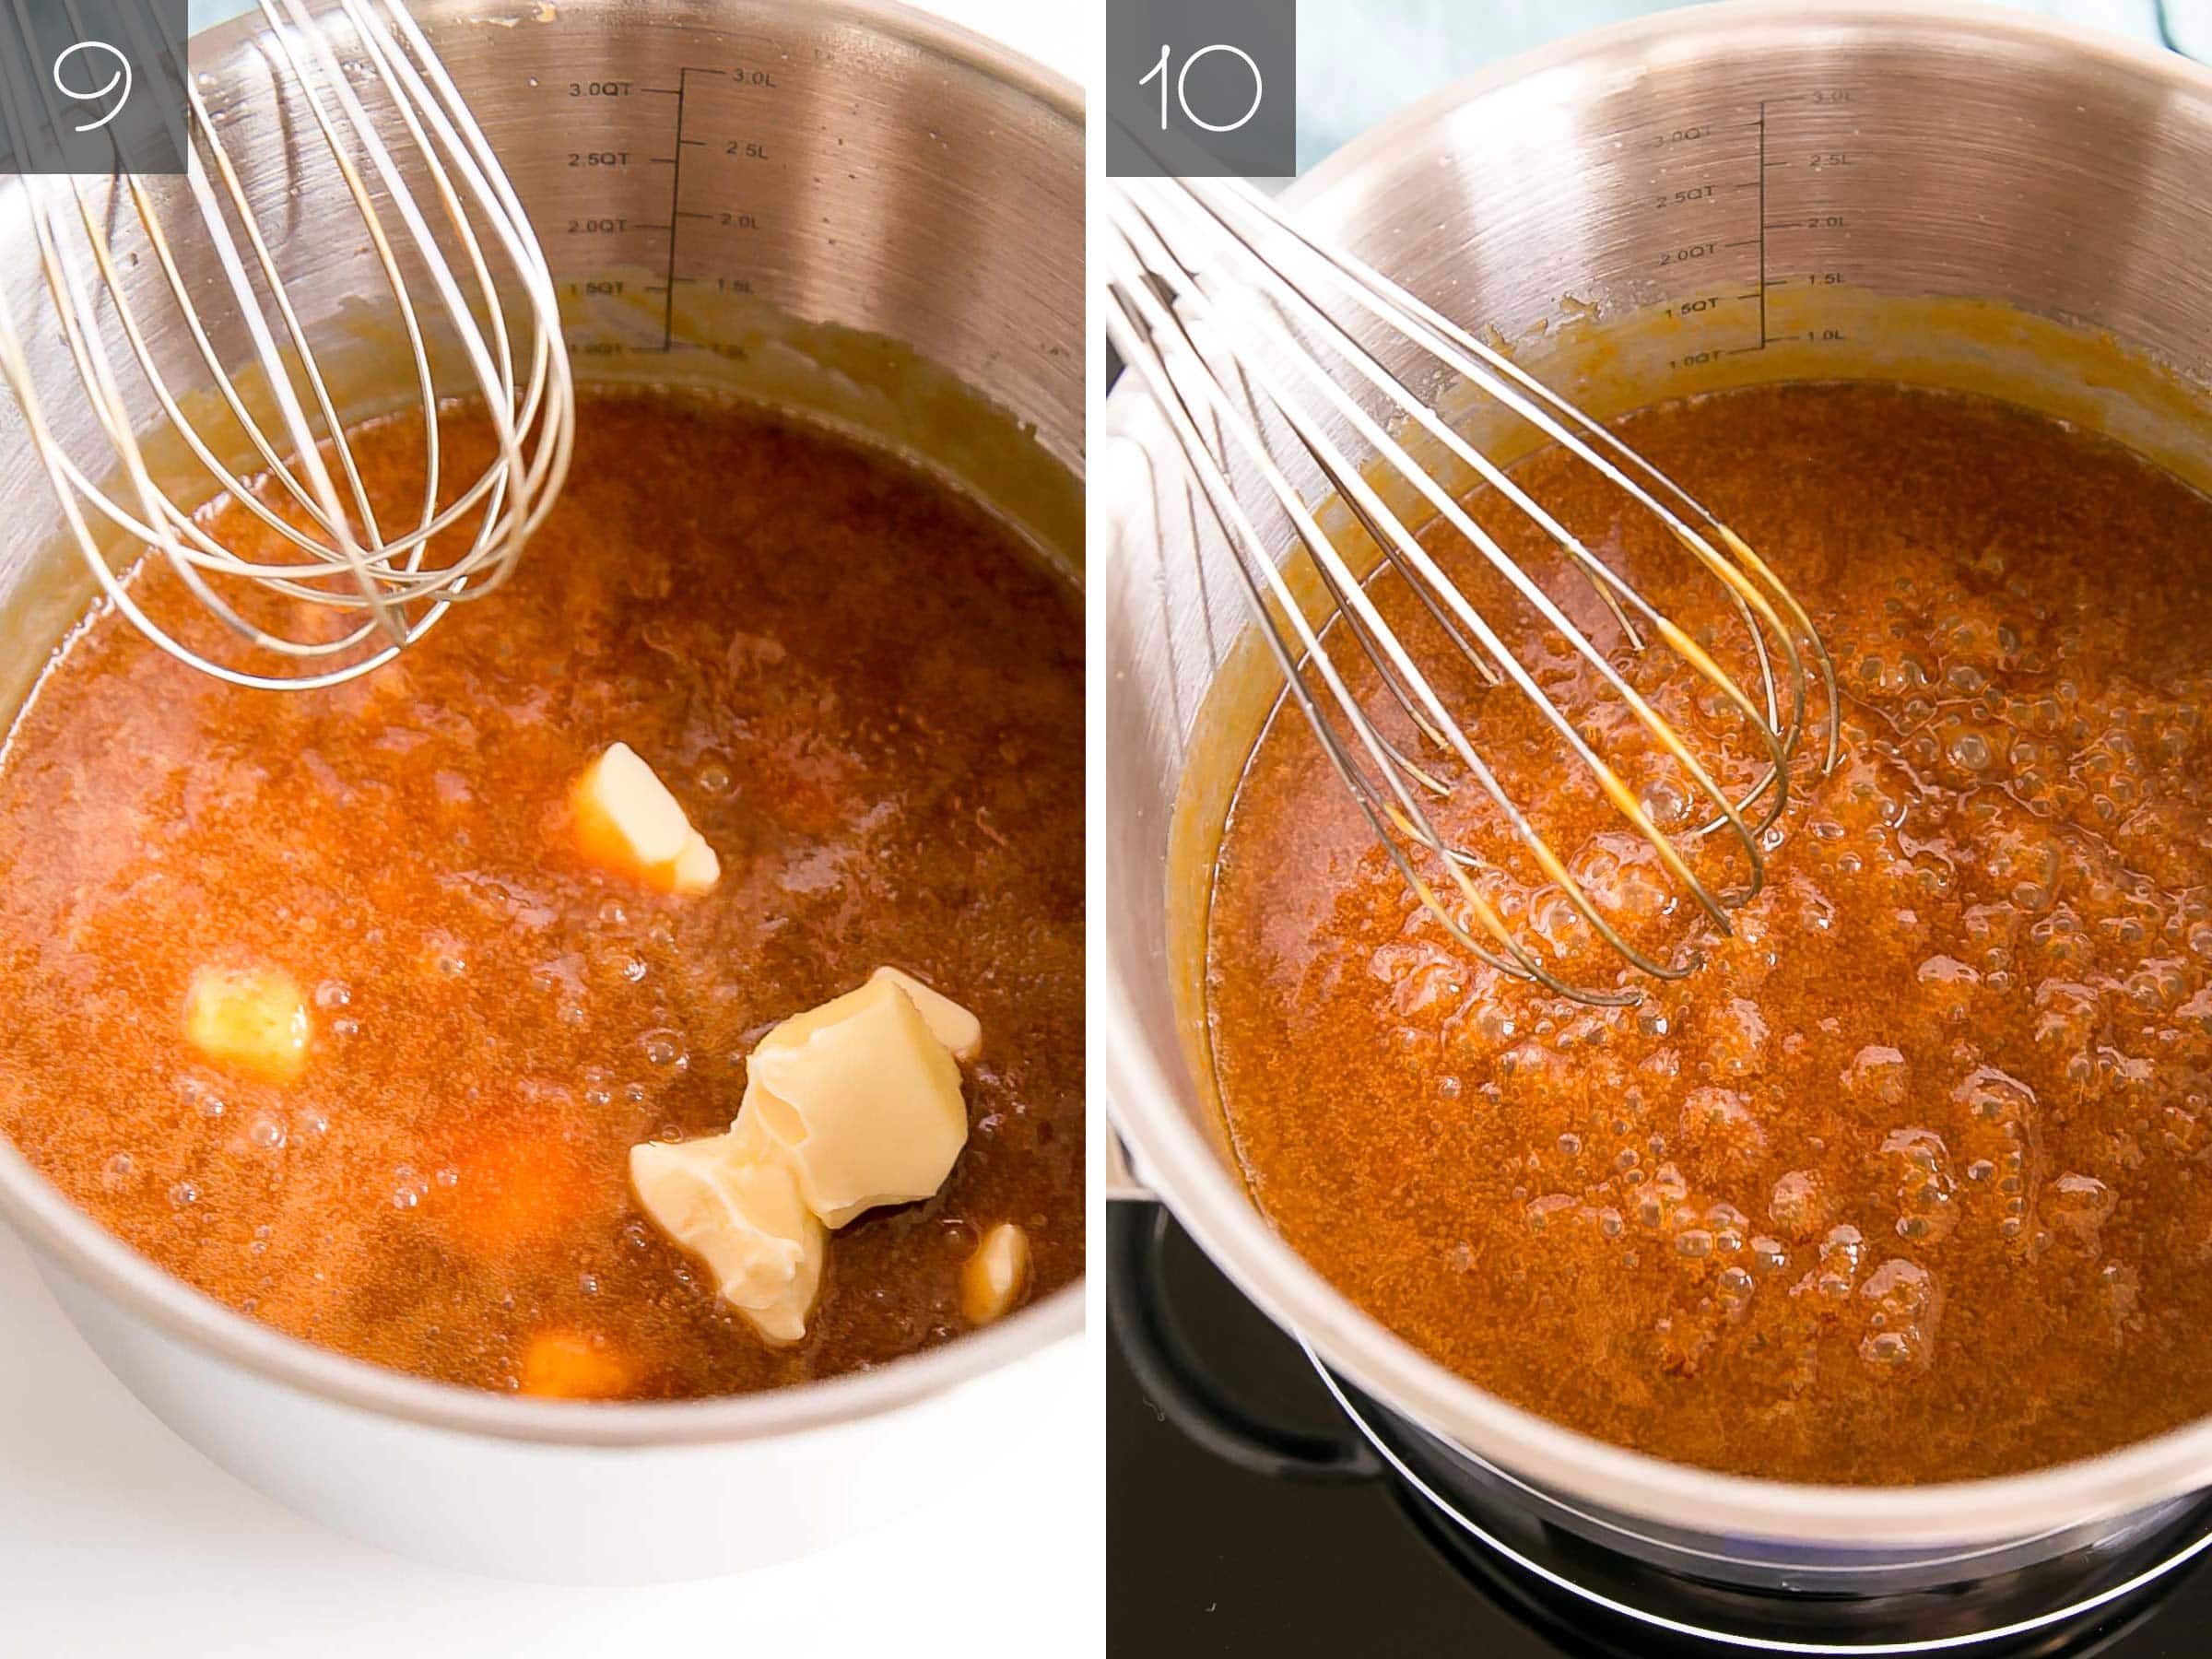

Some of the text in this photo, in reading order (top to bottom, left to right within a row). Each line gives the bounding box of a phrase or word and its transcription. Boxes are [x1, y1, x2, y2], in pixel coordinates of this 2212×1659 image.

[732, 65, 776, 88] 3.0L
[570, 82, 633, 97] 3.0QT
[725, 140, 769, 159] 2.5L
[568, 153, 631, 166] 2.5QT
[1810, 154, 1852, 167] 2.5L
[1655, 185, 1714, 208] 2.5QT
[568, 219, 628, 232] 2.0QT
[721, 213, 760, 229] 2.0L
[1808, 218, 1844, 229] 2.0L
[1659, 243, 1716, 265] 2.0QT
[1808, 273, 1845, 285] 1.5L
[1665, 297, 1719, 319] 1.5QT
[1807, 330, 1845, 341] 1.0L
[1669, 350, 1721, 369] 1.0QT
